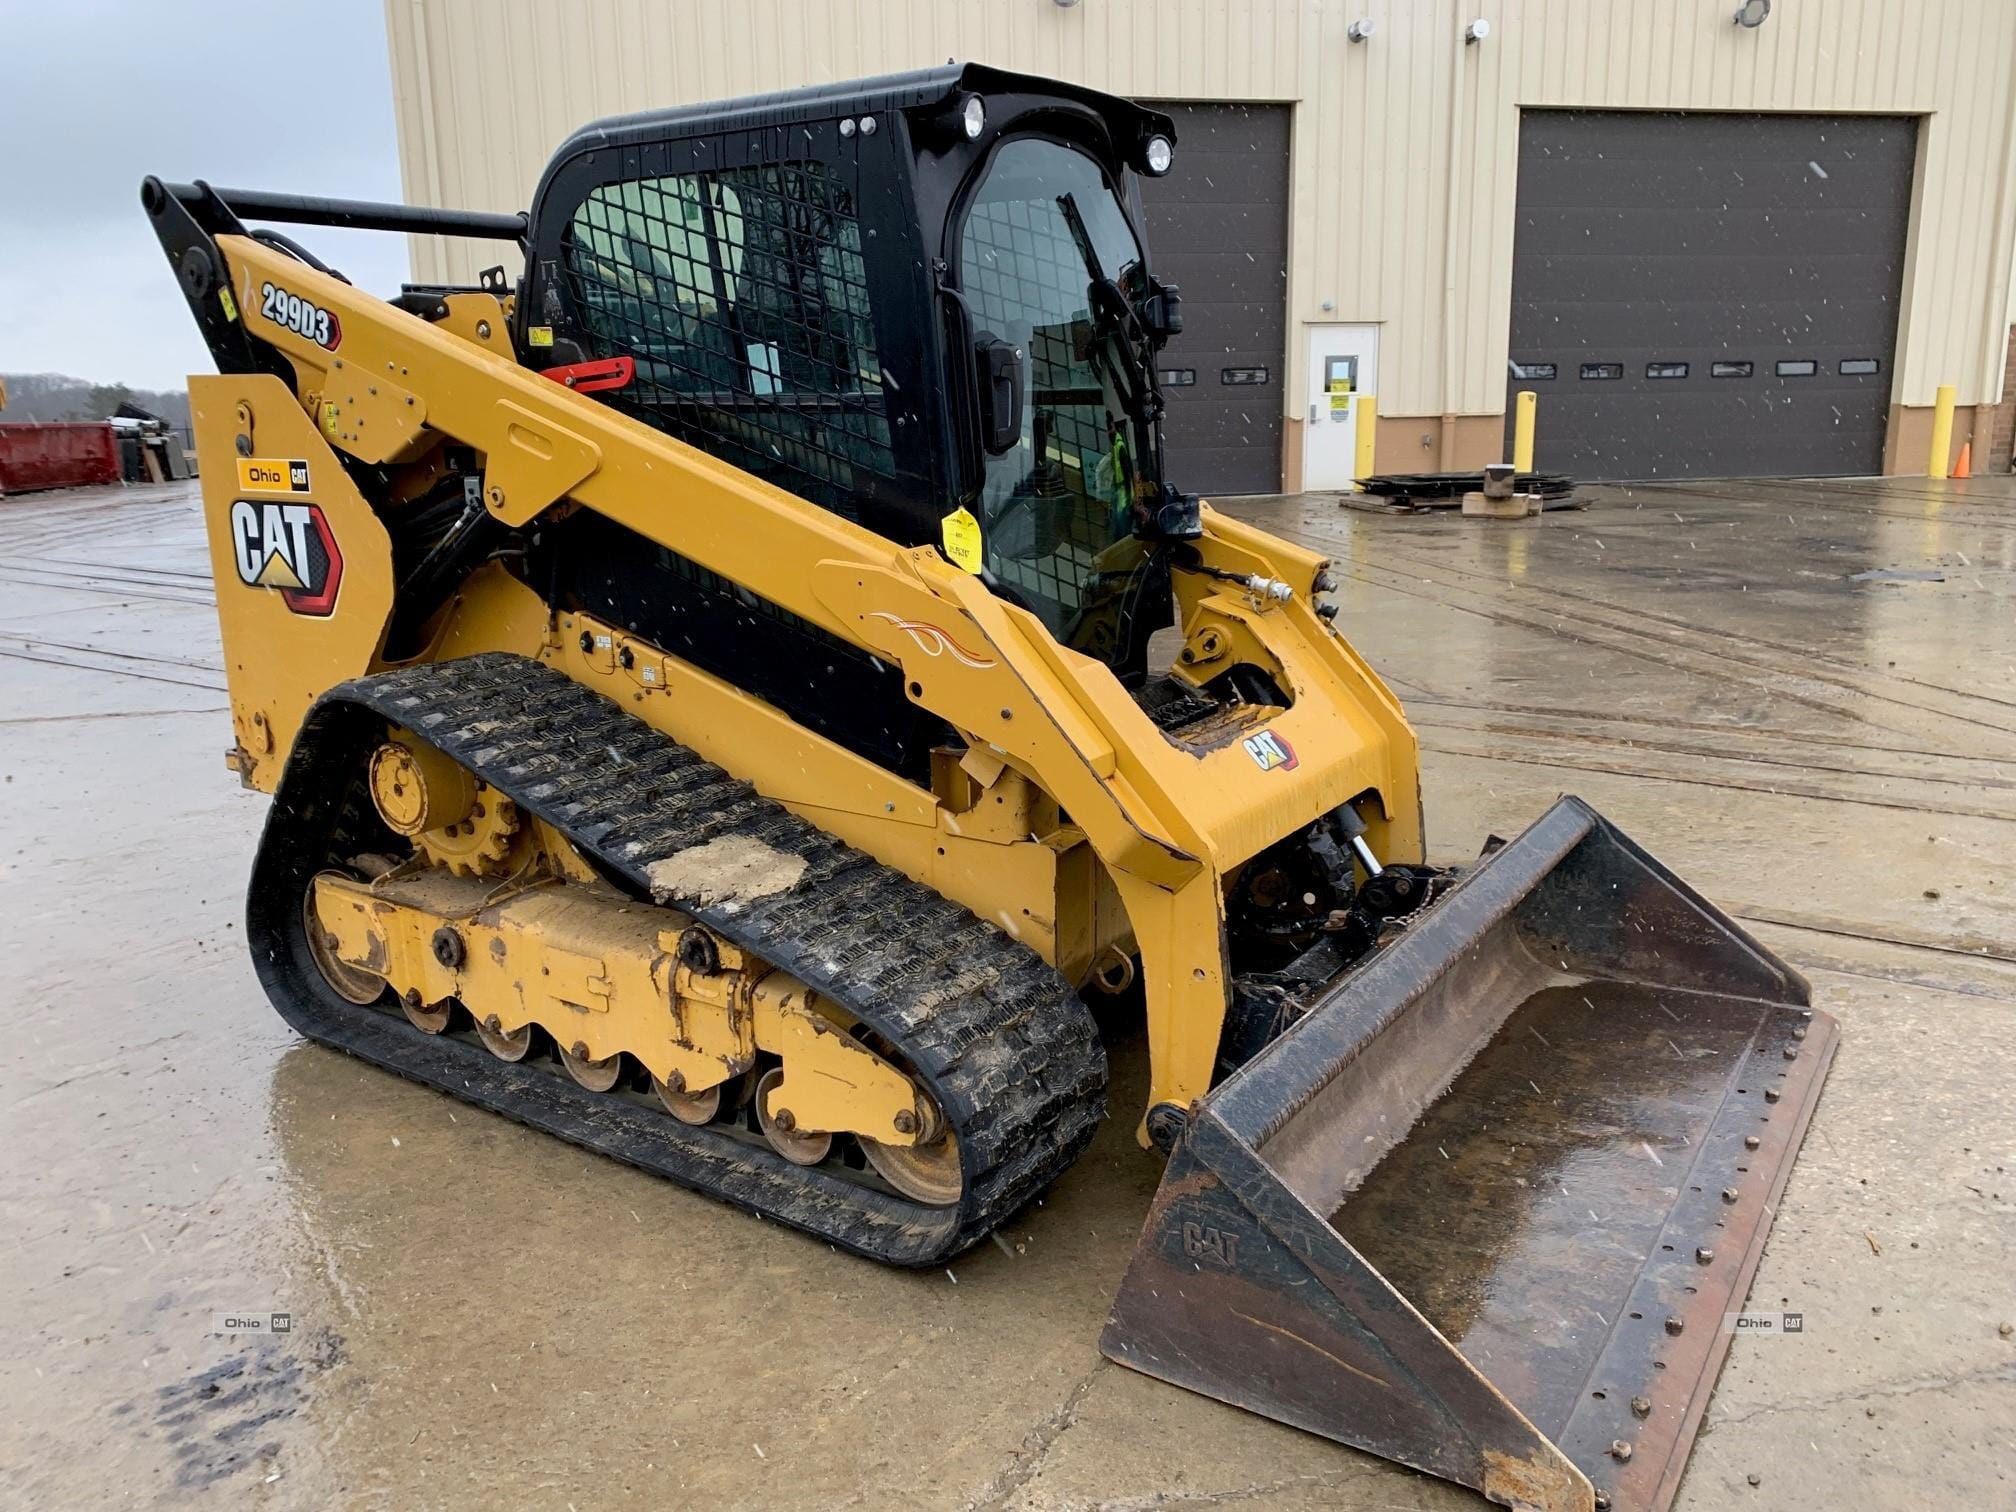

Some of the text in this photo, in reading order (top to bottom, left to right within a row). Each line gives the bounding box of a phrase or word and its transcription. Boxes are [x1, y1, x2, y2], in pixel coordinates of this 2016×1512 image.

[261, 282, 329, 346] 299D3
[249, 467, 307, 484] Ohio CAT
[231, 501, 311, 589] CAT
[1243, 730, 1288, 770] CAT
[1183, 1221, 1240, 1268] CAT
